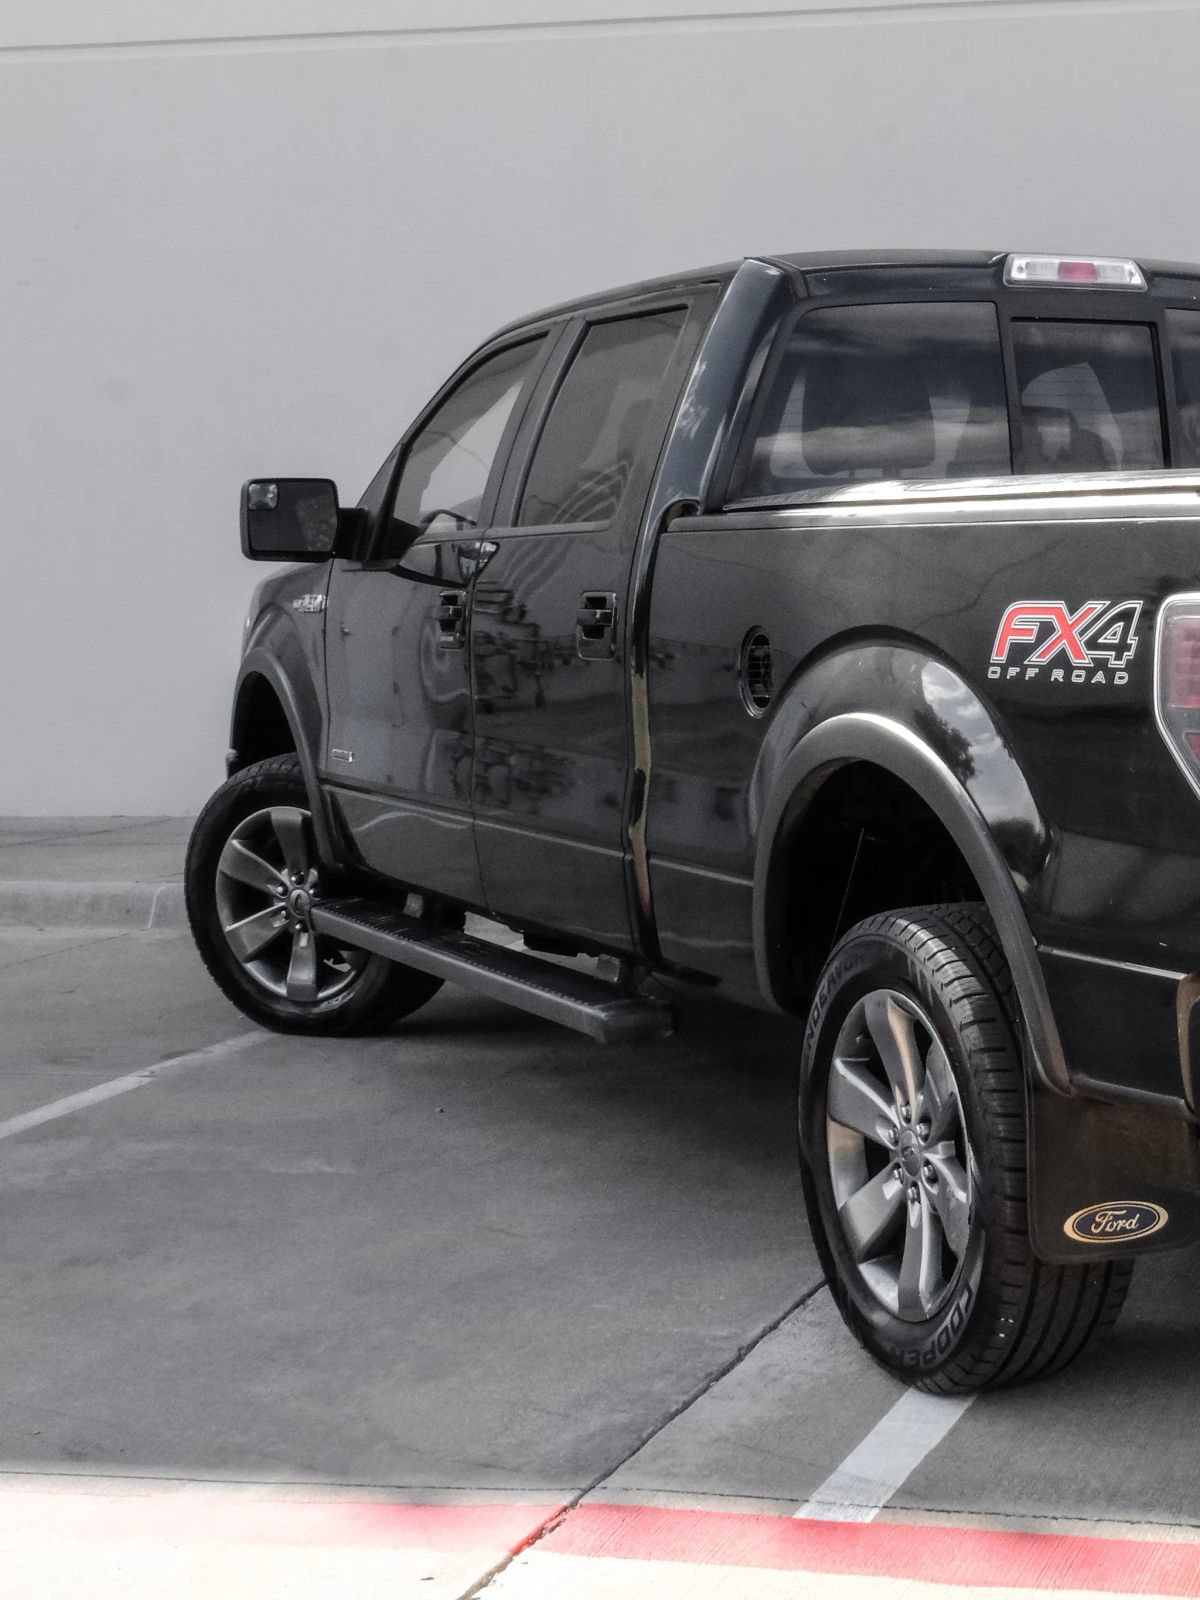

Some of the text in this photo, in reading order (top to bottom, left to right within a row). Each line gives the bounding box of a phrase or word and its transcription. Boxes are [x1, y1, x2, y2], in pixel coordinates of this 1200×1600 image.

[990, 600, 1144, 668] FX4
[987, 666, 1130, 685] OFF ROAD
[1090, 1209, 1140, 1234] Ford
